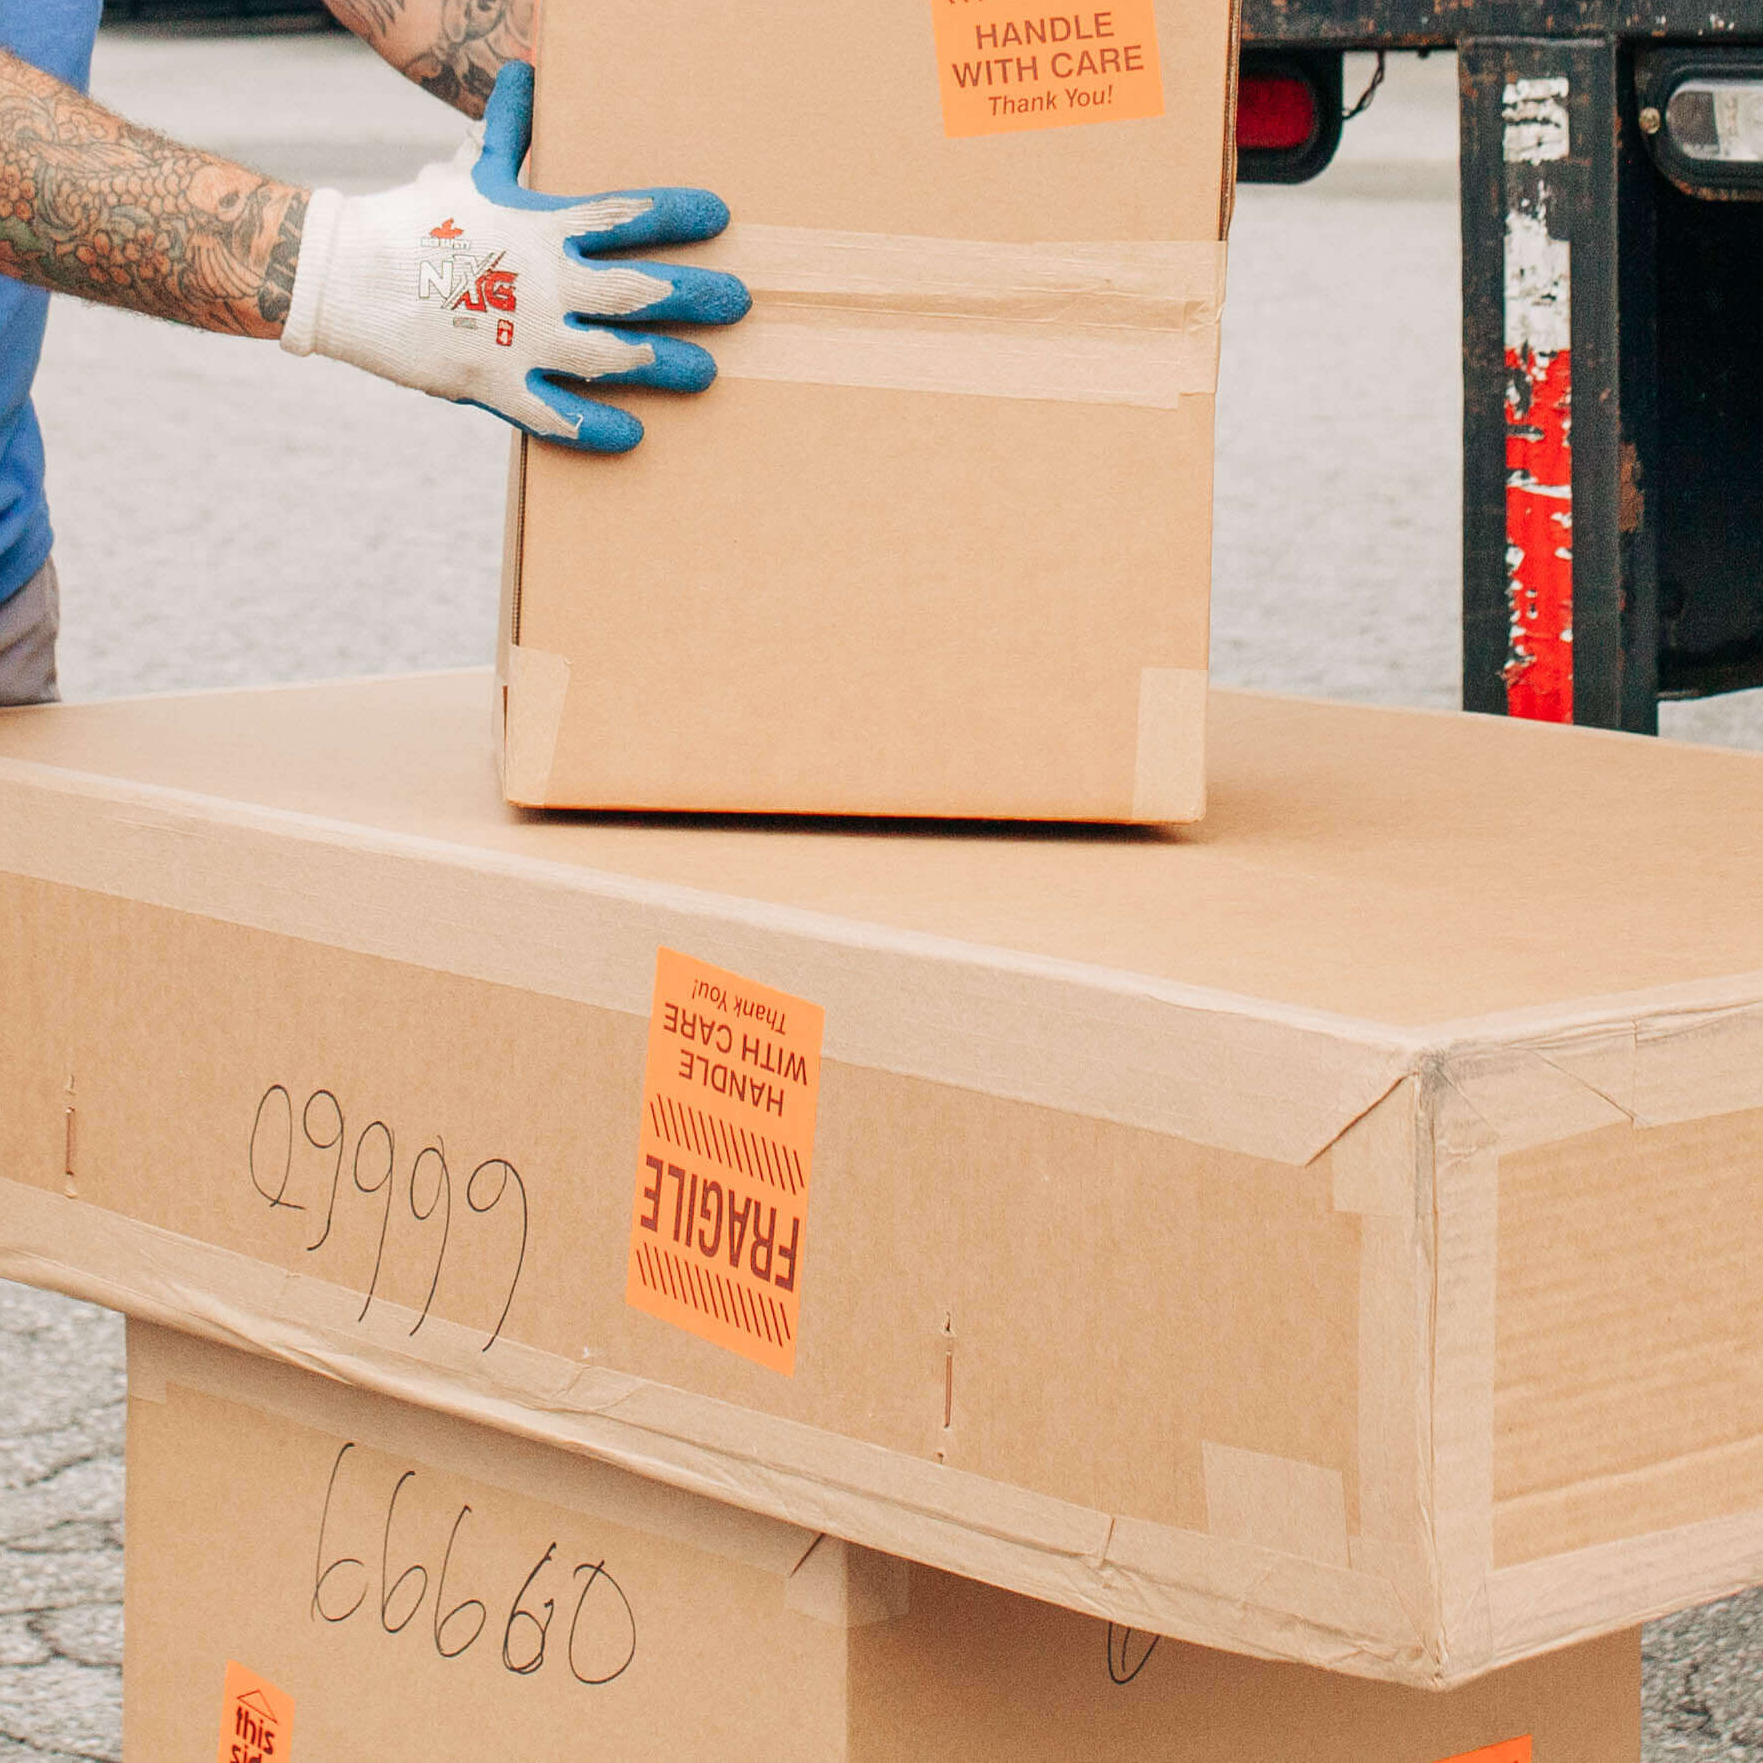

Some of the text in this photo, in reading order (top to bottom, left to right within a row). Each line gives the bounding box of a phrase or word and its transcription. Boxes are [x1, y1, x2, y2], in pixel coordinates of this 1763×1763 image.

[975, 11, 1115, 50] HANDLE
[951, 44, 1145, 89] WITH CARE
[987, 84, 1114, 117] Thank You!
[691, 978, 787, 1036] Thank You!
[662, 1001, 809, 1087] WITH CARE
[677, 1048, 785, 1118] HANDLE
[639, 1153, 801, 1294] FRAGILE
[310, 1441, 637, 1685] 66660
[235, 1704, 275, 1756] this
